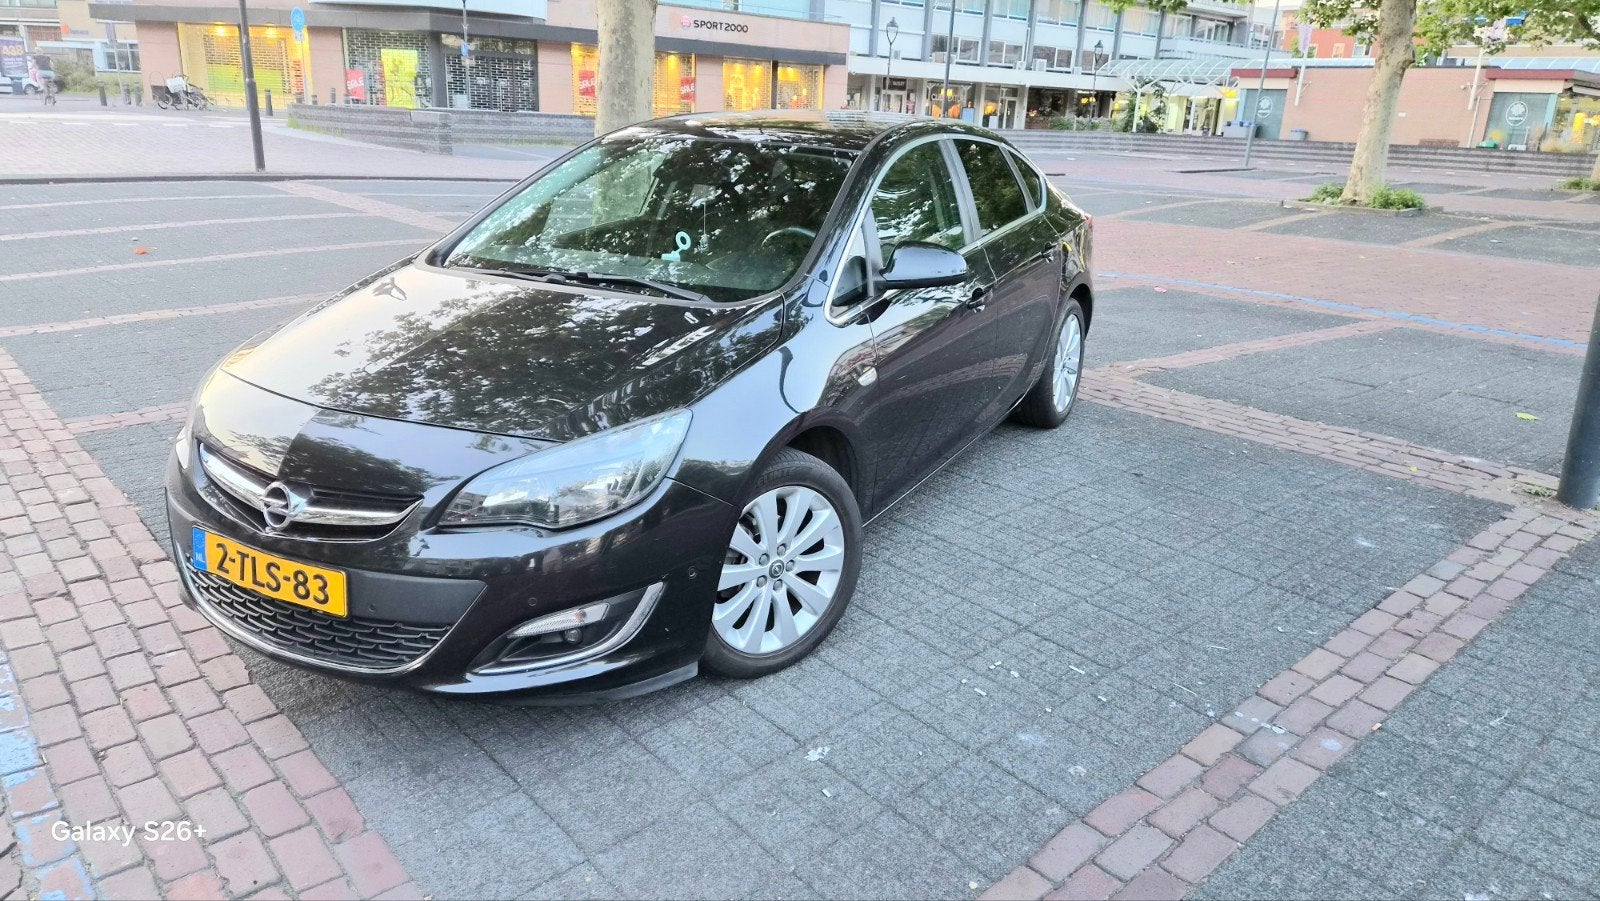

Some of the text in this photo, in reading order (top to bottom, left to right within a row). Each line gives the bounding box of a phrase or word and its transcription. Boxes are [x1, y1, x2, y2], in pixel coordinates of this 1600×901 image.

[693, 19, 749, 33] SPORT2000
[346, 77, 364, 90] SALE
[579, 78, 596, 90] SALE
[680, 83, 695, 94] SALE
[195, 552, 206, 563] NL
[216, 542, 330, 605] 2-TLS-83
